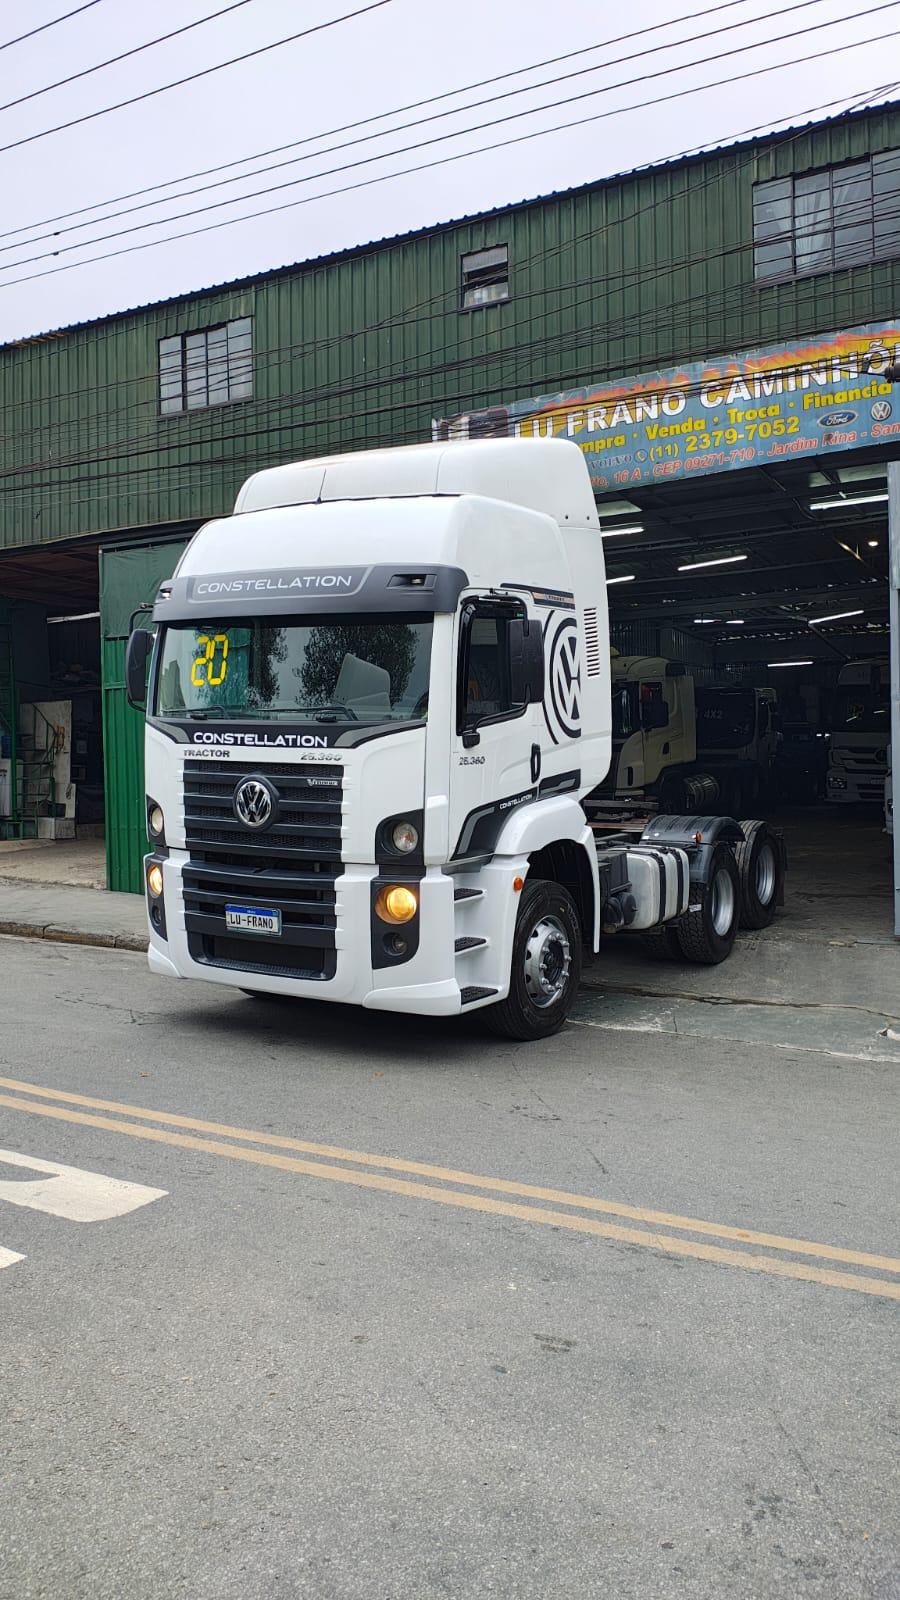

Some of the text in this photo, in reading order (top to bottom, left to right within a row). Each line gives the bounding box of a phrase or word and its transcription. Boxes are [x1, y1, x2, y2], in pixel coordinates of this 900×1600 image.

[566, 389, 687, 437] FRANO
[579, 380, 892, 454] mpra Venda Troca Financia
[649, 416, 800, 461] (11) 2379-7052
[588, 454, 632, 469] VOLVO
[614, 469, 629, 483] 16
[631, 467, 641, 480] A
[653, 459, 682, 477] CEP
[684, 446, 755, 471] 09271-710
[767, 437, 818, 457] Jardim
[822, 430, 857, 446] Rina
[197, 575, 352, 594] CONSTELLATION
[191, 634, 228, 686] 20
[184, 749, 230, 758] TRACTOR
[193, 732, 328, 747] CONSTELLATION
[230, 913, 274, 929] LU-FRANO
